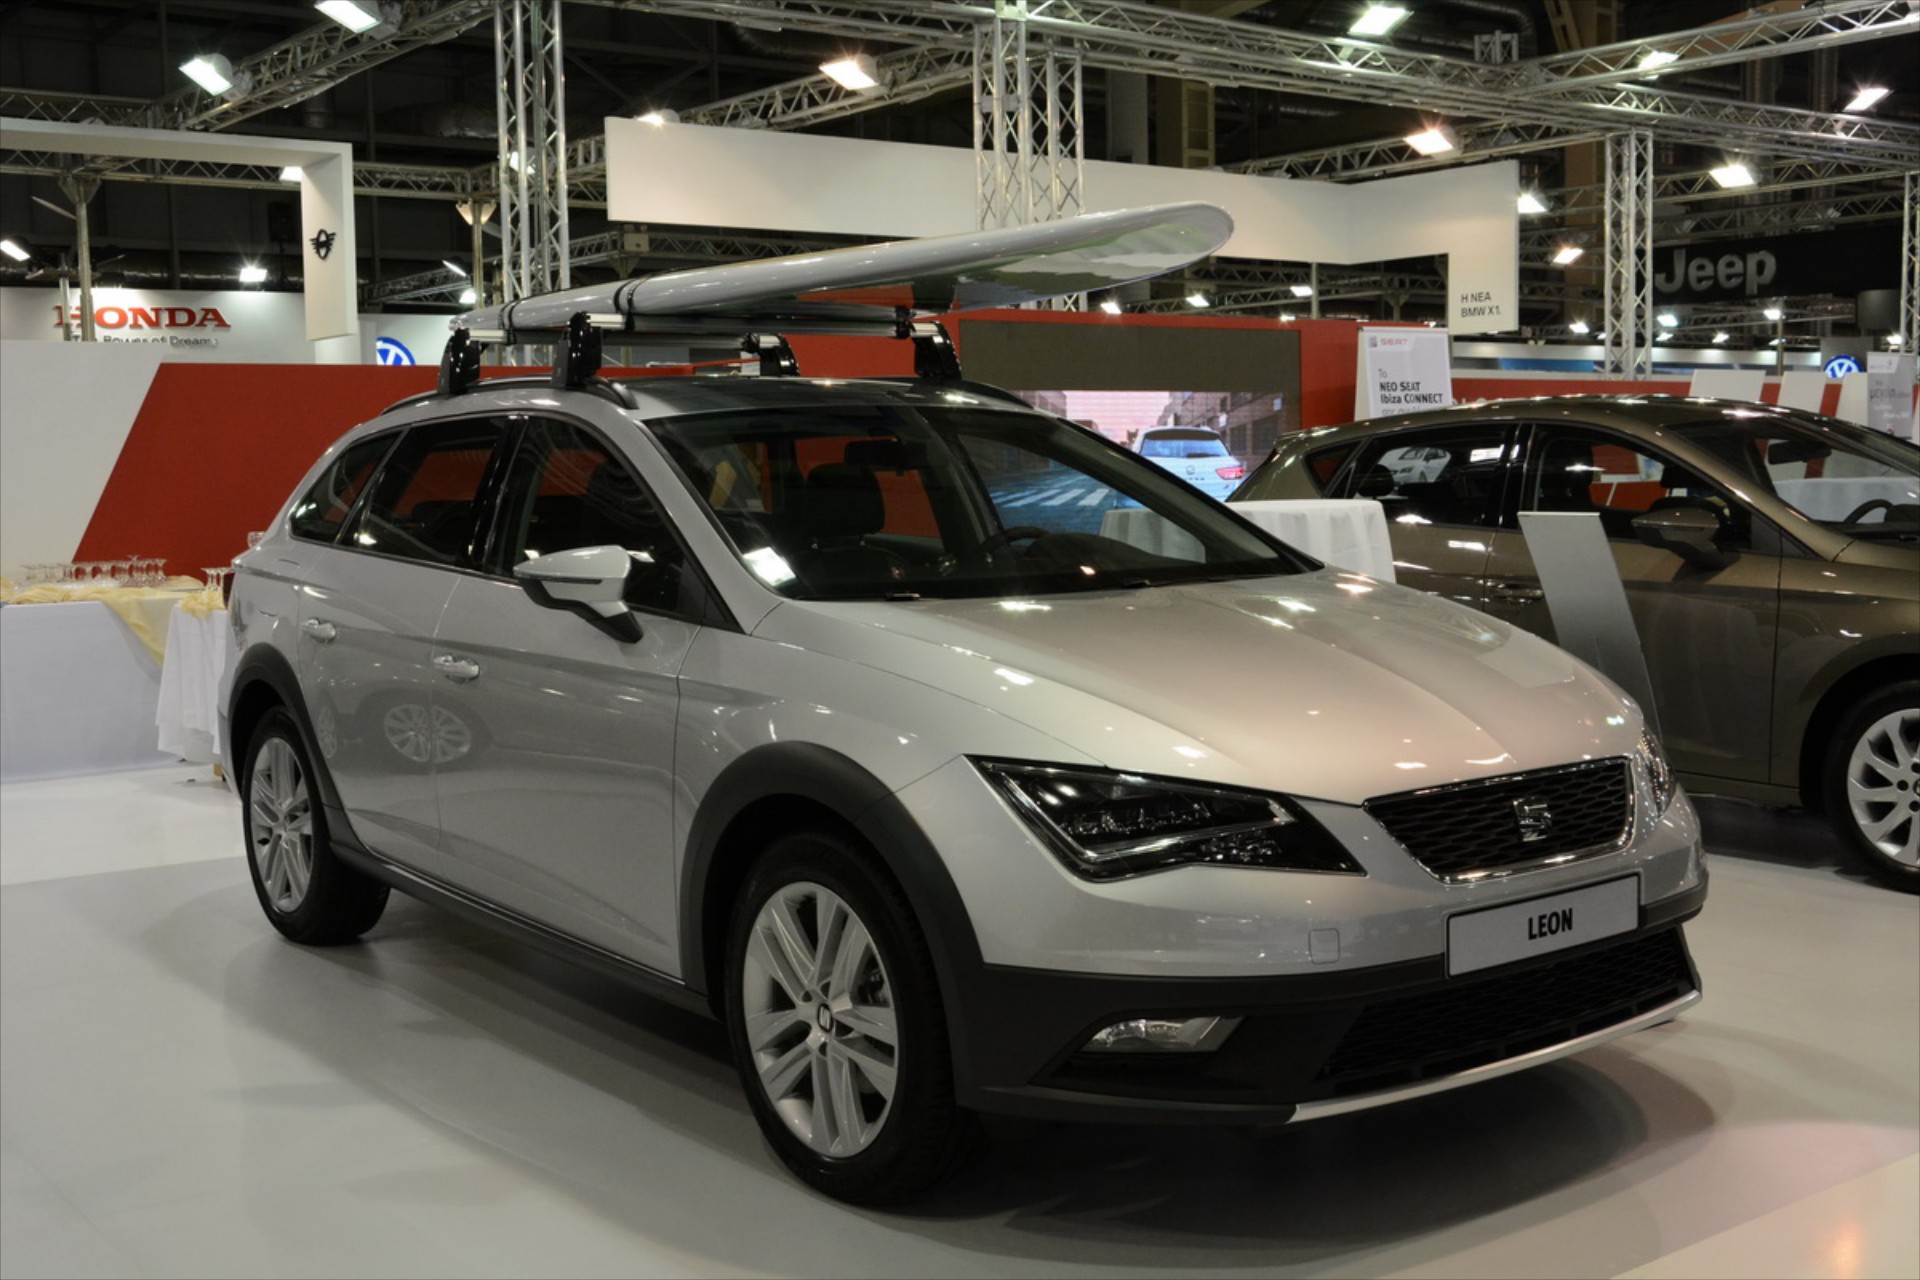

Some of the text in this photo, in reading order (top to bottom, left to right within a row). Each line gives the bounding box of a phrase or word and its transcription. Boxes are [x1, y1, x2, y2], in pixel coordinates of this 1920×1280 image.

[1654, 247, 1776, 295] Jeep
[1460, 306, 1487, 318] BMW
[1400, 381, 1421, 392] SEAT
[1380, 394, 1402, 404] Ibiza
[1404, 393, 1443, 404] CONNECT
[1528, 908, 1573, 940] LEON
